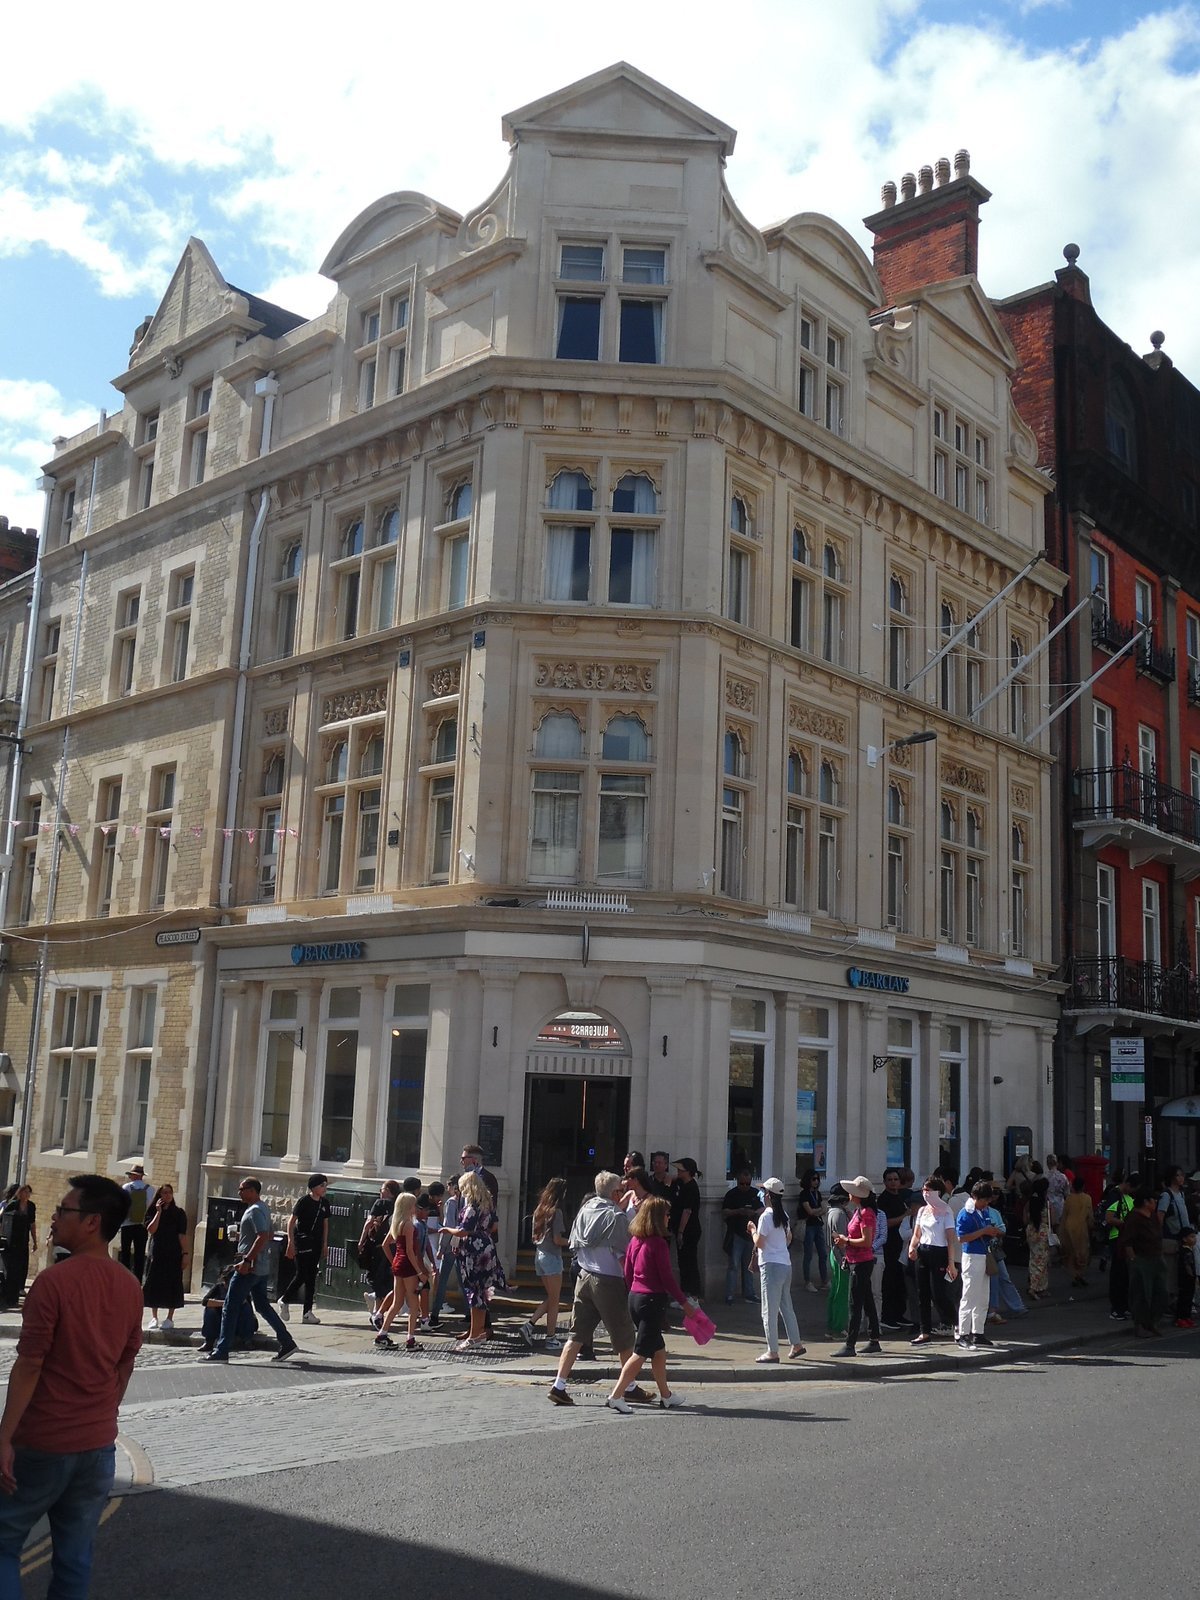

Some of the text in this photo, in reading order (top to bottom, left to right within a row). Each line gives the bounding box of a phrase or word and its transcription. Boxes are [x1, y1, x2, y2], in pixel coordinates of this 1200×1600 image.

[181, 932, 198, 940] STREET
[304, 942, 361, 960] BARCLAYS
[862, 971, 910, 992] BARCLAYS
